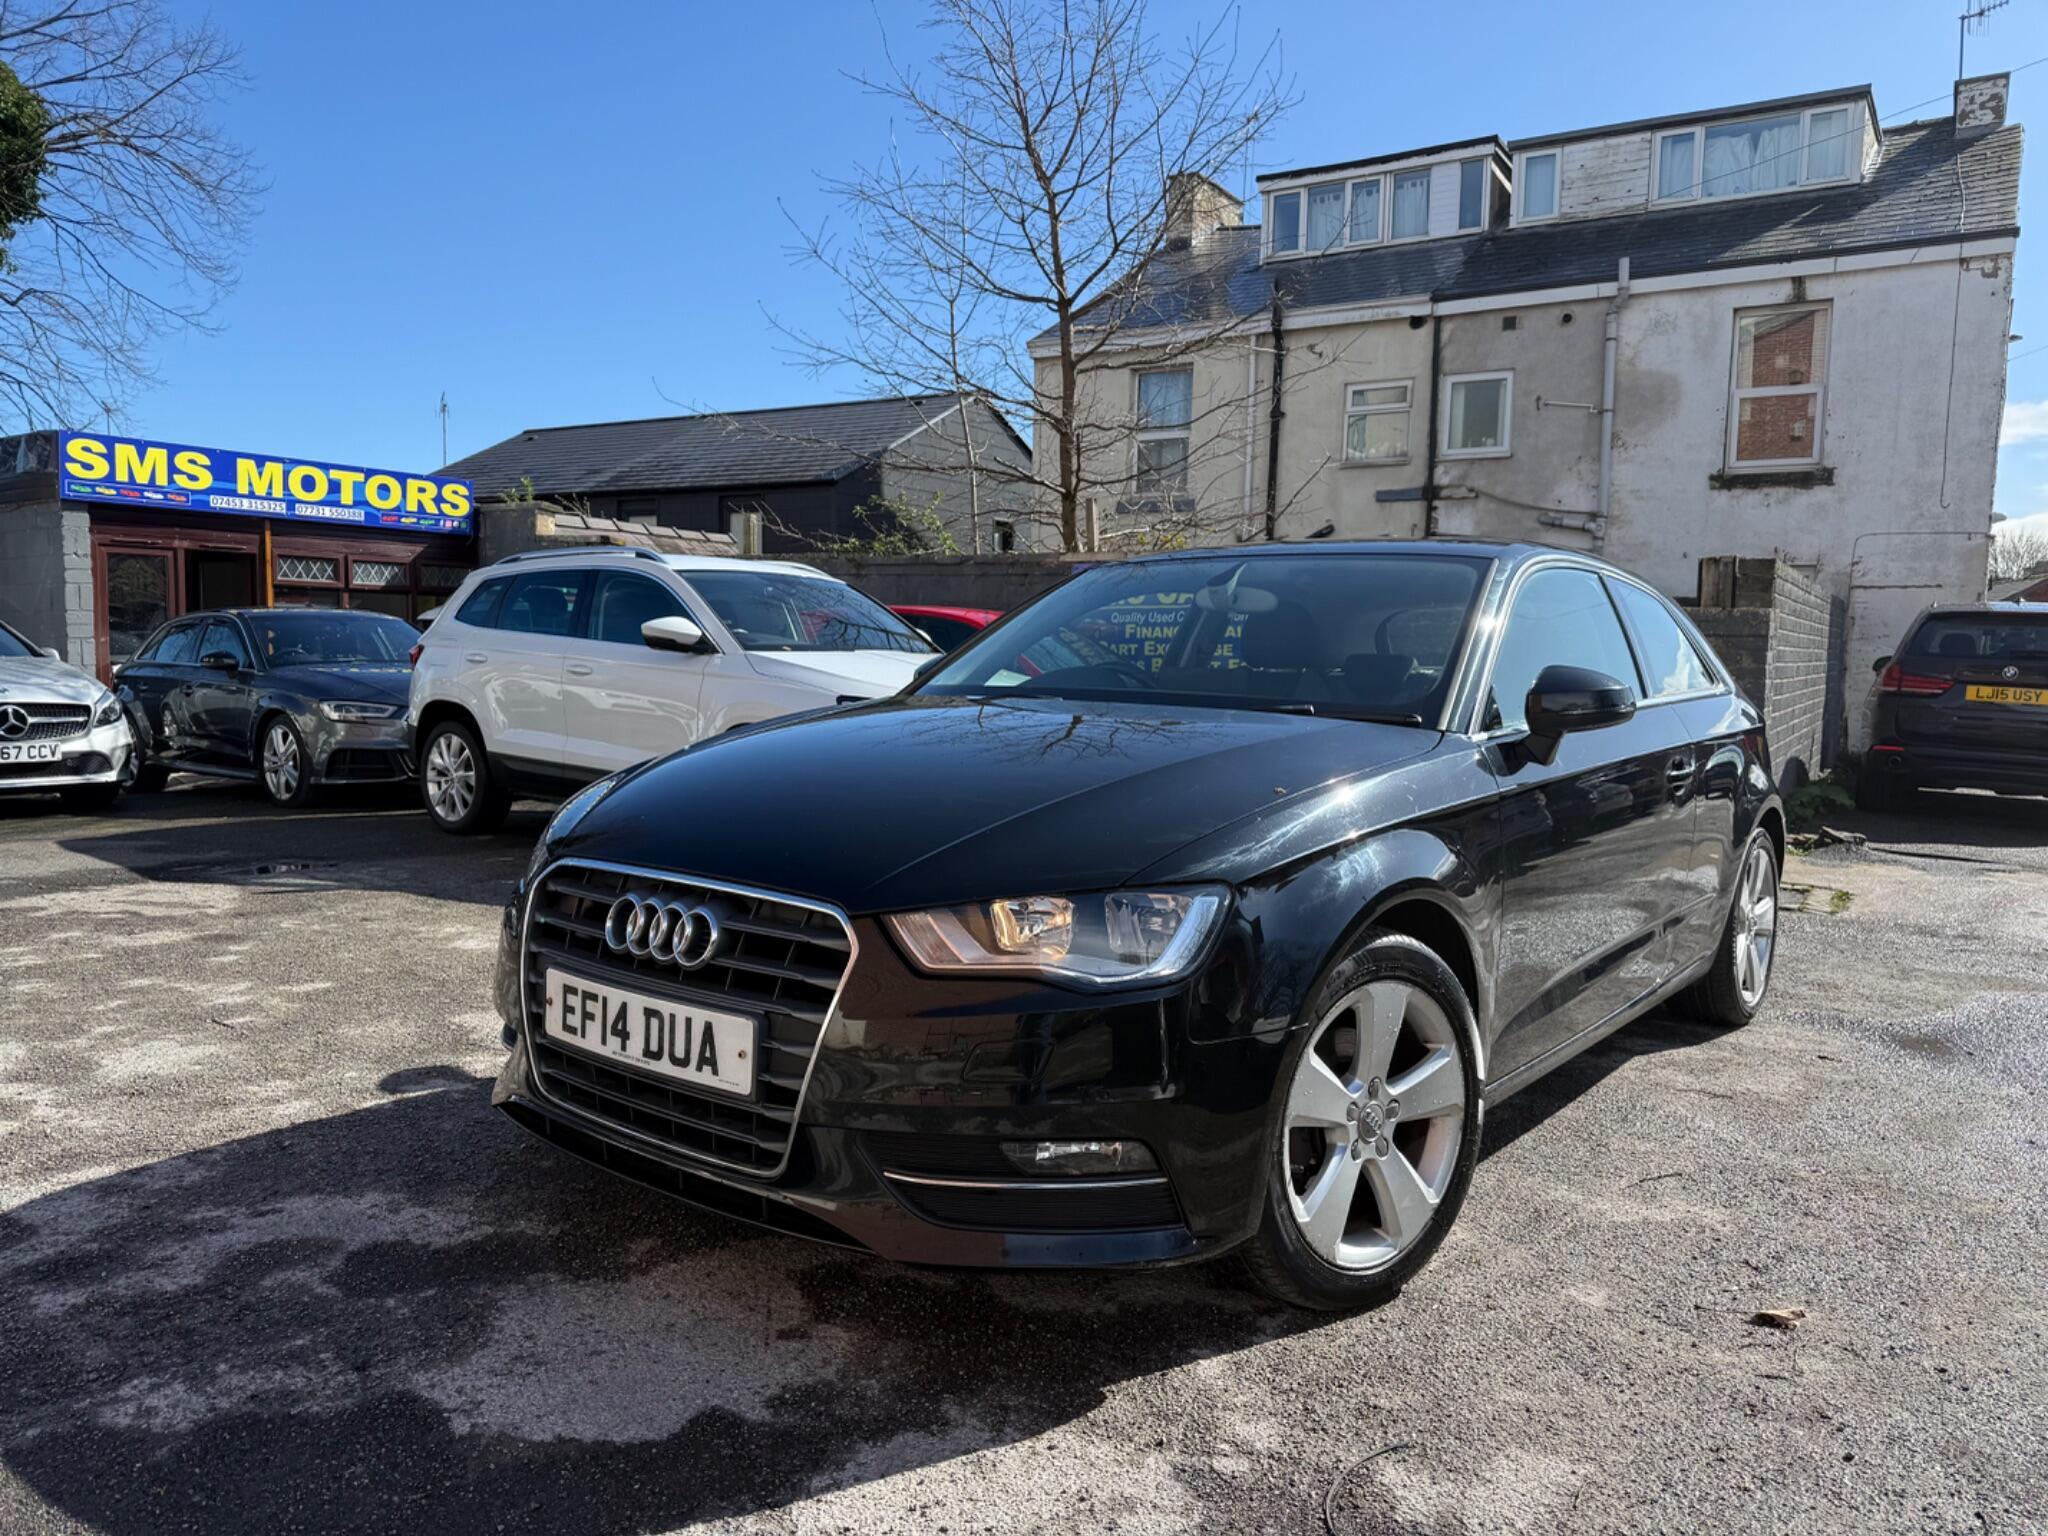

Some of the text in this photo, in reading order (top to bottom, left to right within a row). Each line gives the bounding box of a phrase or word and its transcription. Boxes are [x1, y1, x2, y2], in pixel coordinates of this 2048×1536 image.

[65, 438, 470, 517] SMS MOTORS
[211, 496, 243, 509] 07453
[1111, 612, 1146, 624] Quality
[1148, 611, 1175, 622] Used
[2013, 688, 2043, 702] USY
[0, 744, 59, 760] 67 CCV
[561, 983, 719, 1077] EF14 DUA
